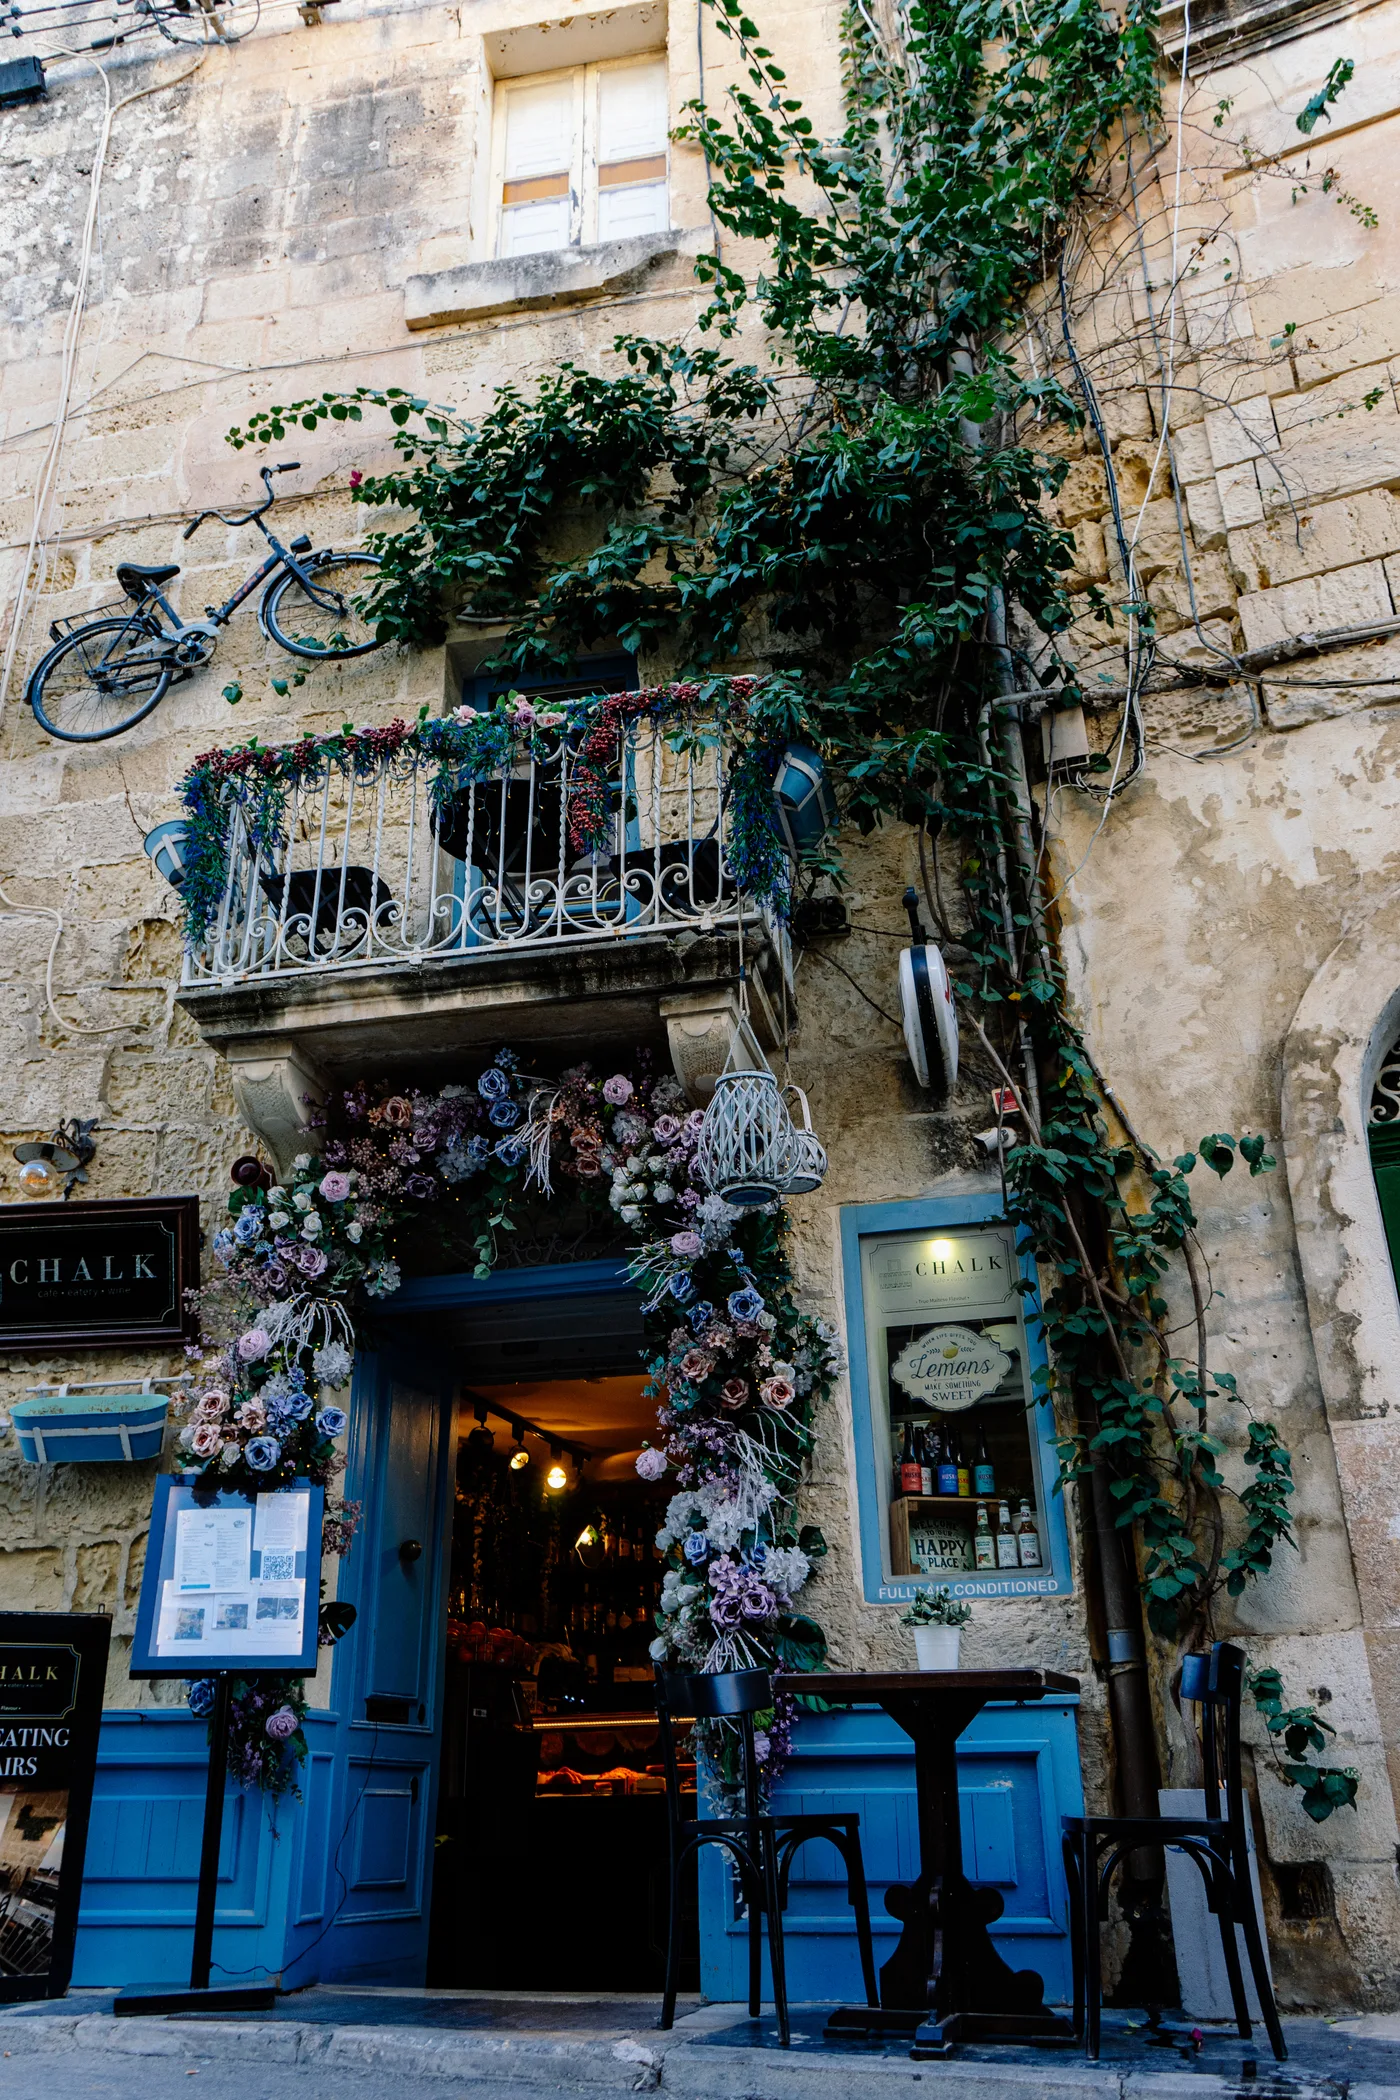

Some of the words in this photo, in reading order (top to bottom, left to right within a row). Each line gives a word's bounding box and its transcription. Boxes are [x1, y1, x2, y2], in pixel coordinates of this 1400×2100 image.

[9, 1253, 157, 1284] CHALK
[915, 1255, 1003, 1277] CHALK
[921, 1337, 935, 1349] WHEN
[949, 1332, 965, 1340] GIVES
[966, 1337, 977, 1346] YOU
[909, 1353, 995, 1379] Lemons
[924, 1382, 941, 1391] MAKE
[945, 1380, 981, 1389] SOMETHING
[932, 1389, 974, 1402] SWEET
[914, 1538, 967, 1557] HAPPY
[927, 1556, 959, 1569] PLACE
[954, 1579, 1058, 1596] CONDITIONED
[0, 1757, 38, 1776] IRS
